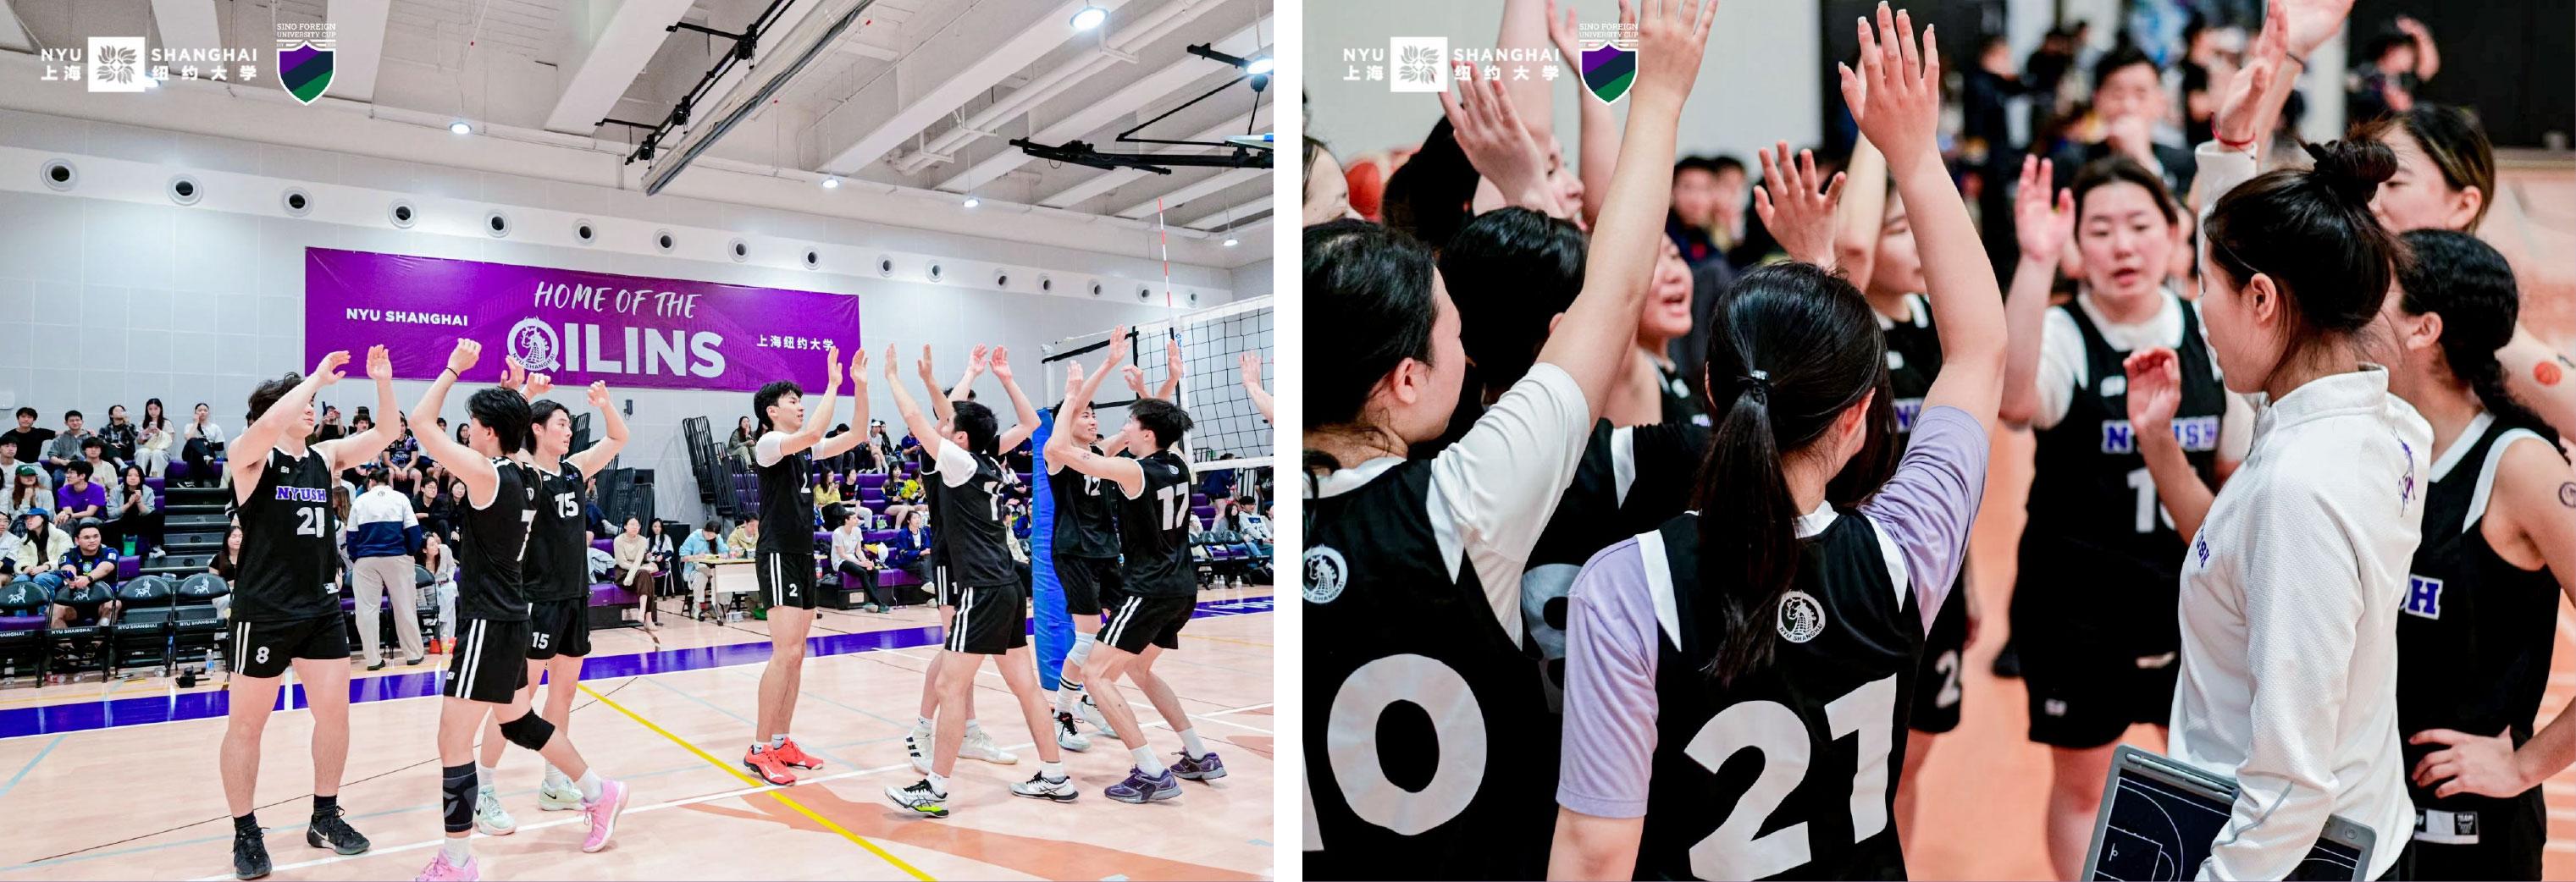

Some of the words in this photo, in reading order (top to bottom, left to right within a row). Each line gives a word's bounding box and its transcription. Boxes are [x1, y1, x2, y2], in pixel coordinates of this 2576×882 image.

[534, 281, 612, 312] HOME
[616, 288, 654, 317] OF
[654, 290, 703, 318] THE
[345, 307, 381, 322] NYU
[384, 310, 468, 327] SHANGHAI
[507, 315, 726, 378] QILINS
[756, 334, 834, 352] 上海纽约大学
[275, 485, 328, 503] NYUSH
[554, 491, 579, 518] 15
[1156, 481, 1190, 531] 17
[2126, 468, 2178, 533] 1
[296, 506, 325, 538] 21
[788, 582, 799, 598] 2
[532, 631, 550, 650] 15
[1778, 626, 1793, 639] NYU
[1792, 622, 1824, 642] SHANGHAI
[255, 646, 270, 664] 8
[1302, 653, 1488, 852] 0
[1683, 672, 1898, 882] 21
